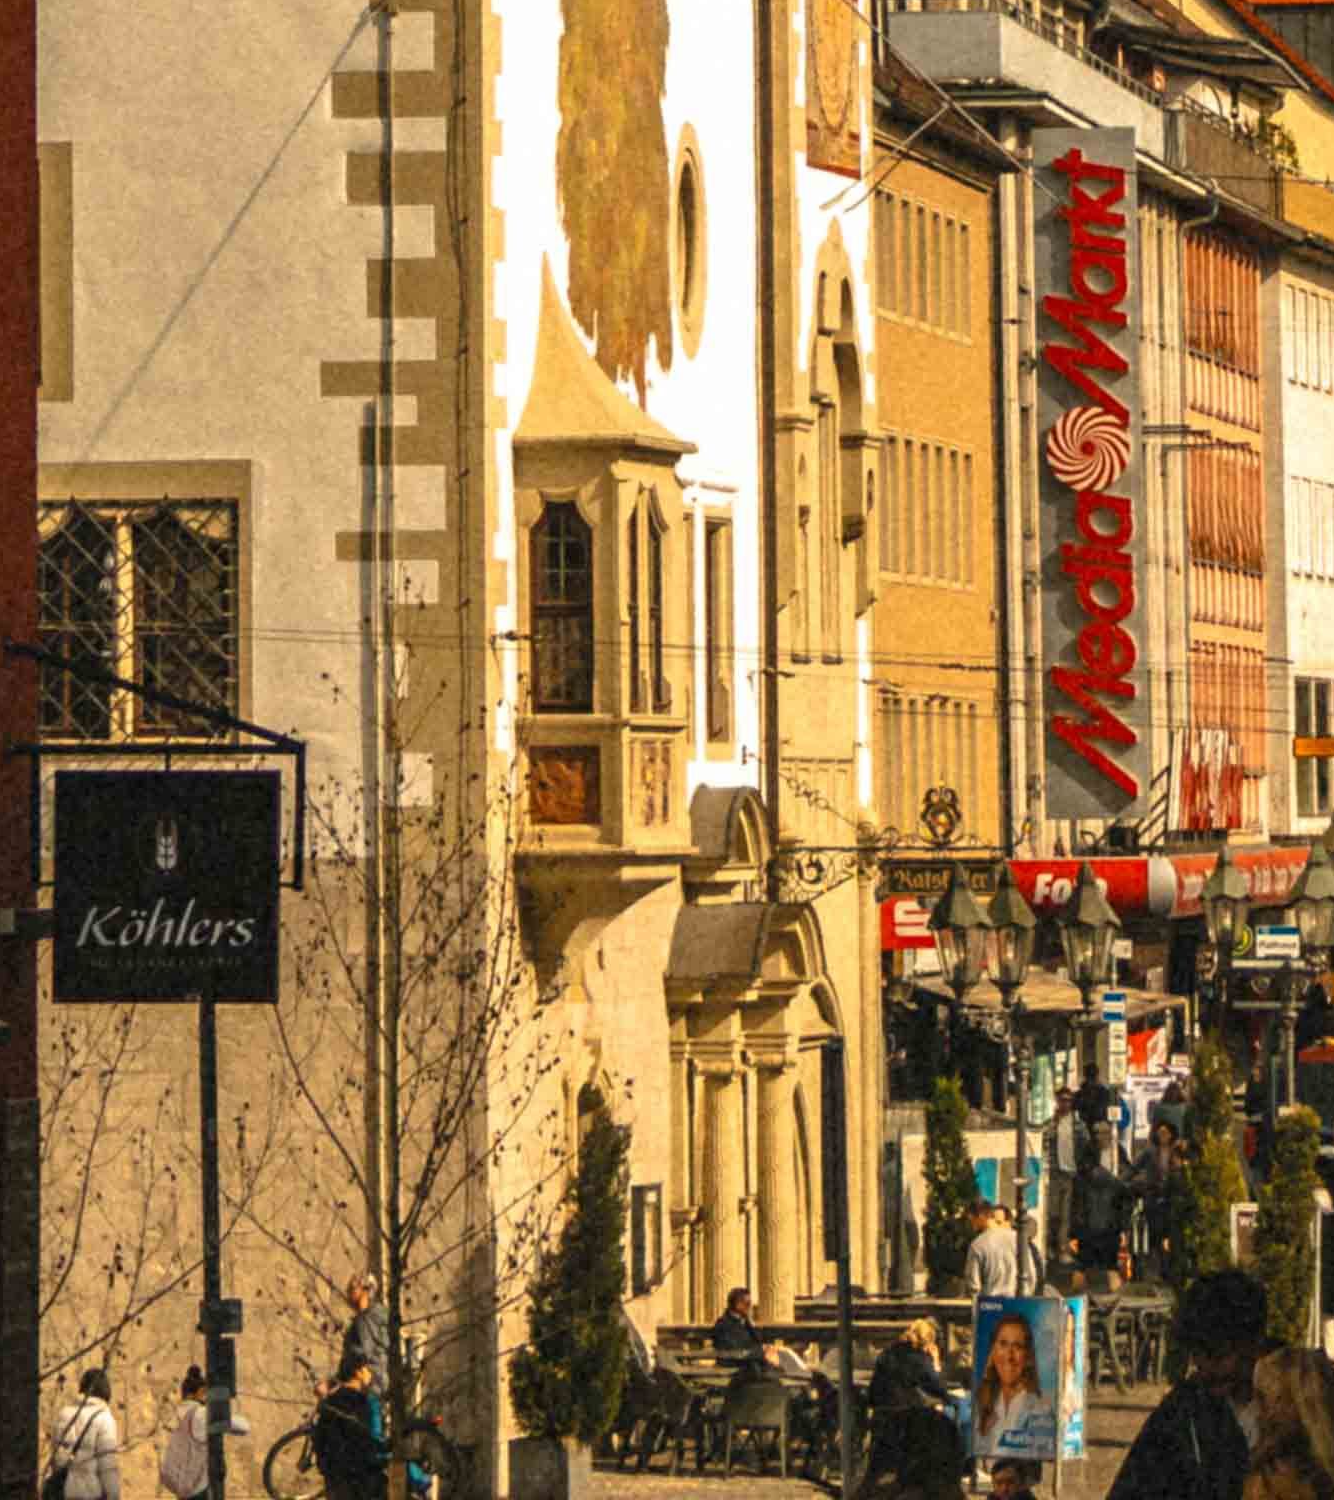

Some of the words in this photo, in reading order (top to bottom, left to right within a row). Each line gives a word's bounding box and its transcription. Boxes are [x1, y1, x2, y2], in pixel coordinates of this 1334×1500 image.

[1043, 148, 1130, 429] Markt
[1052, 491, 1138, 798] Media
[76, 897, 256, 949] Köhlers
